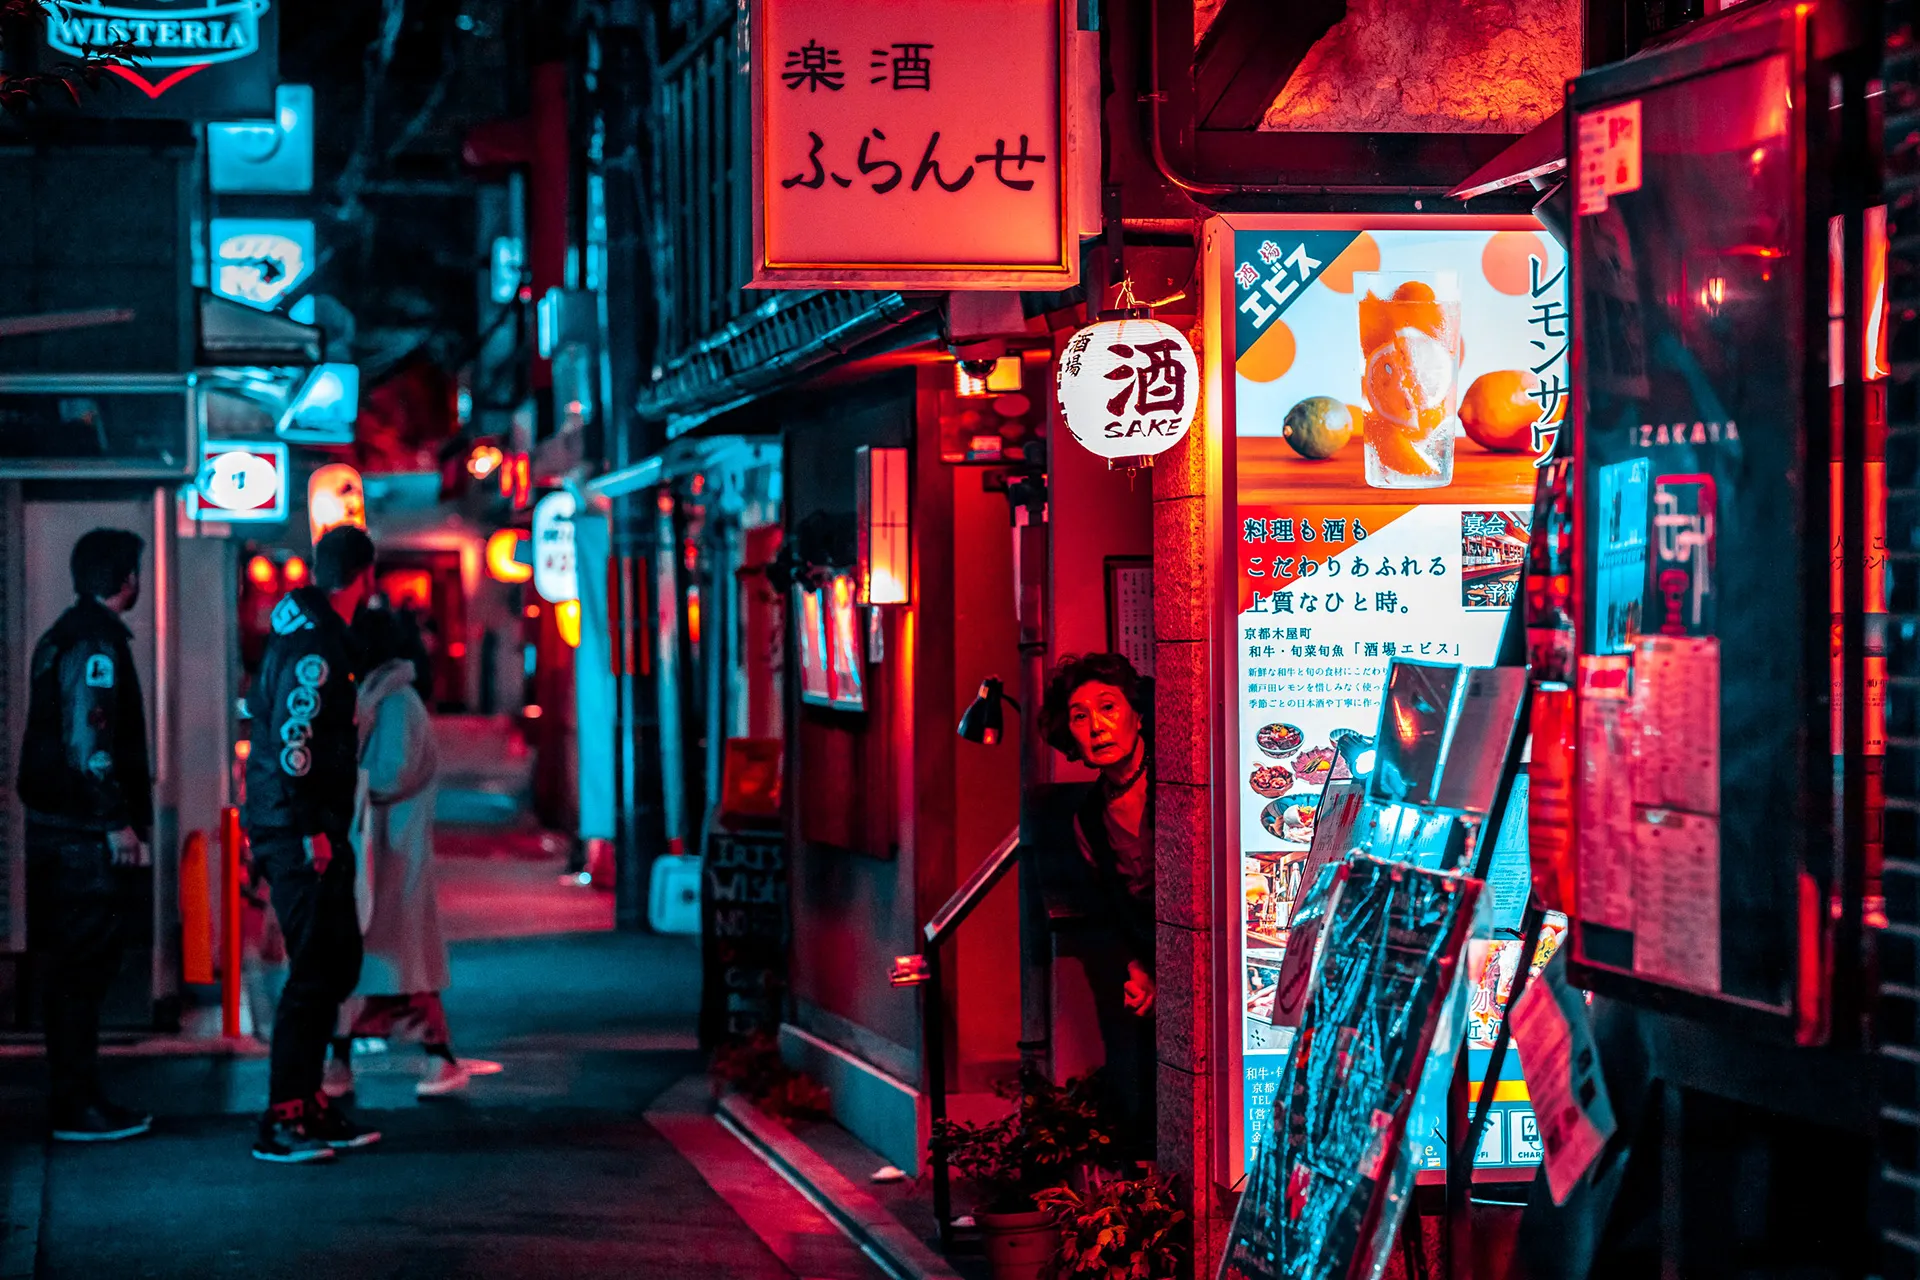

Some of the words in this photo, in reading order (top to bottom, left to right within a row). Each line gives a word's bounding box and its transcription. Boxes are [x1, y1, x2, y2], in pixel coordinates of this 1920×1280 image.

[56, 17, 249, 49] WISTERIA
[781, 127, 1046, 194] ふらんせ
[1236, 241, 1281, 289] 酒場
[1239, 242, 1323, 329] エビス
[1065, 332, 1094, 377] 酒場
[1103, 338, 1187, 417] 酒
[1104, 417, 1183, 439] SAKE
[1244, 518, 1369, 543] 料理も酒も
[1463, 513, 1533, 537] 宴会・
[1248, 556, 1447, 578] こだわりあふれる
[1246, 591, 1411, 615] 上質なひと時。
[1244, 627, 1312, 641] 京都木屋町
[1248, 682, 1387, 693] 瀬戸田レモンを惜しみなく使っ
[1252, 1082, 1279, 1094] 京都
[1252, 1095, 1271, 1105] TEL
